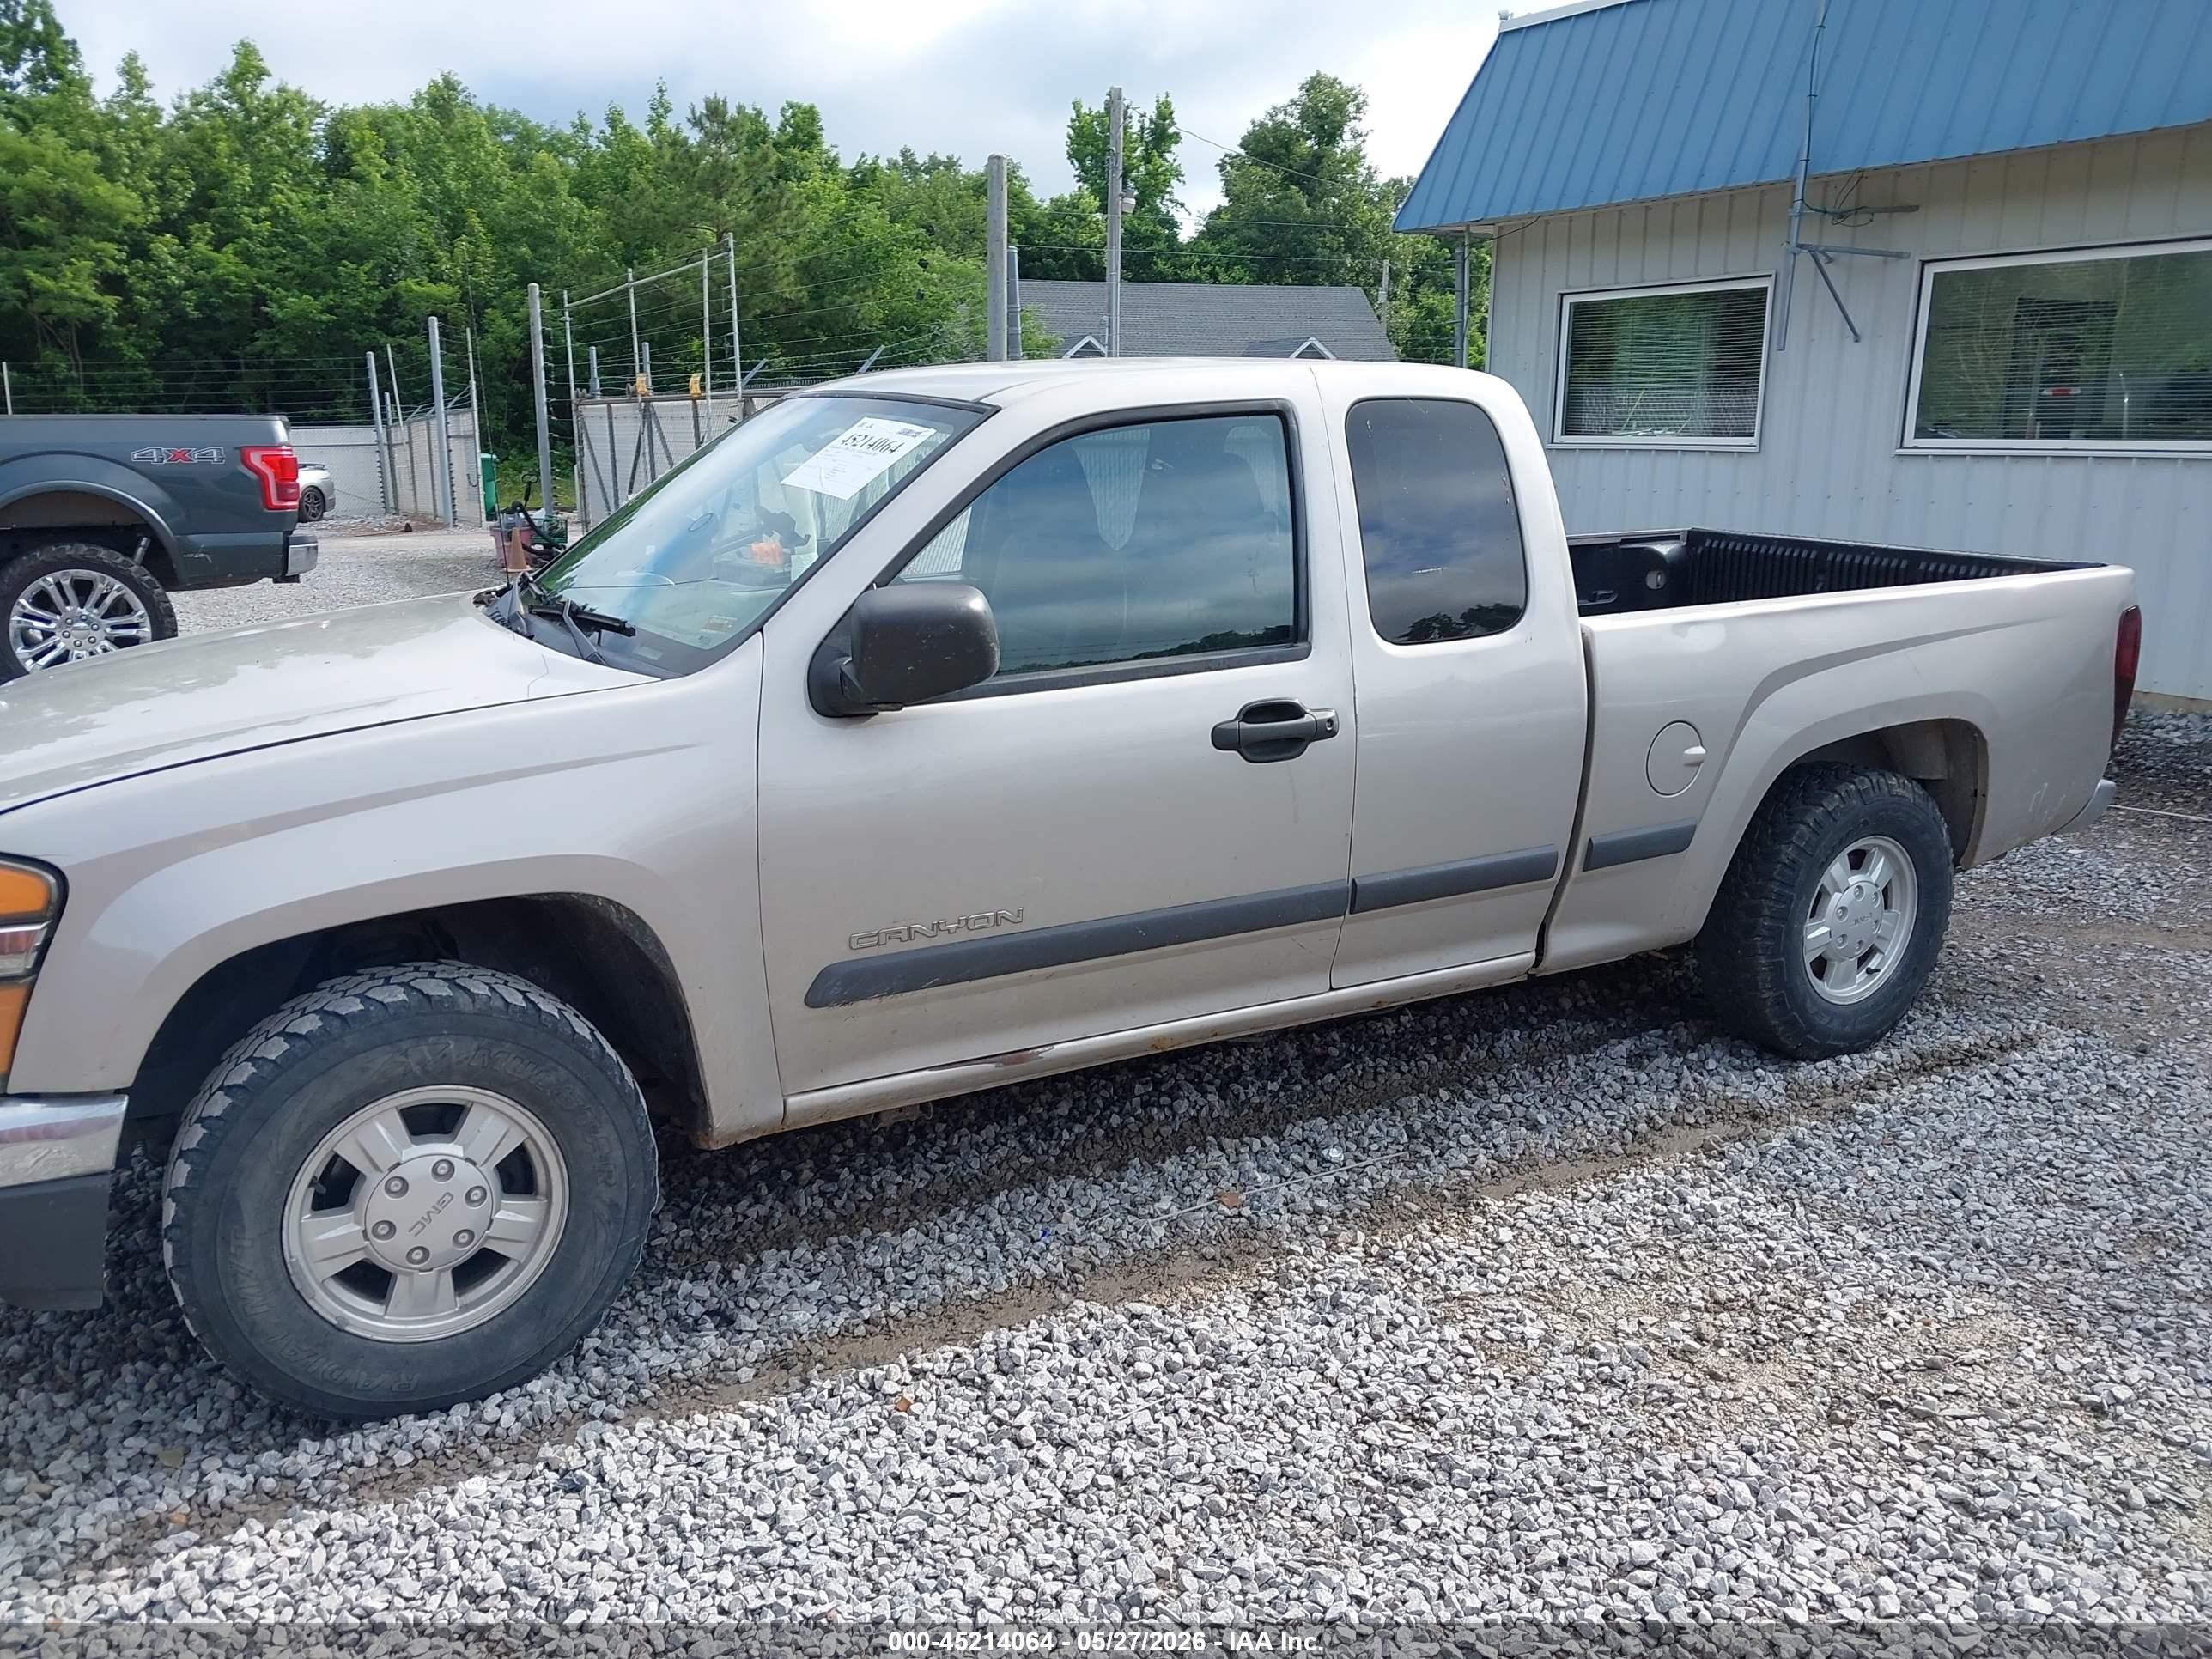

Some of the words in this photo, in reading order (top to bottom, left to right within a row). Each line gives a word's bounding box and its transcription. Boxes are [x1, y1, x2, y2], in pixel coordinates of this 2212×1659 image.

[841, 433, 905, 454] 45214064
[849, 907, 1024, 951] CANYON
[407, 1192, 454, 1237] GMC
